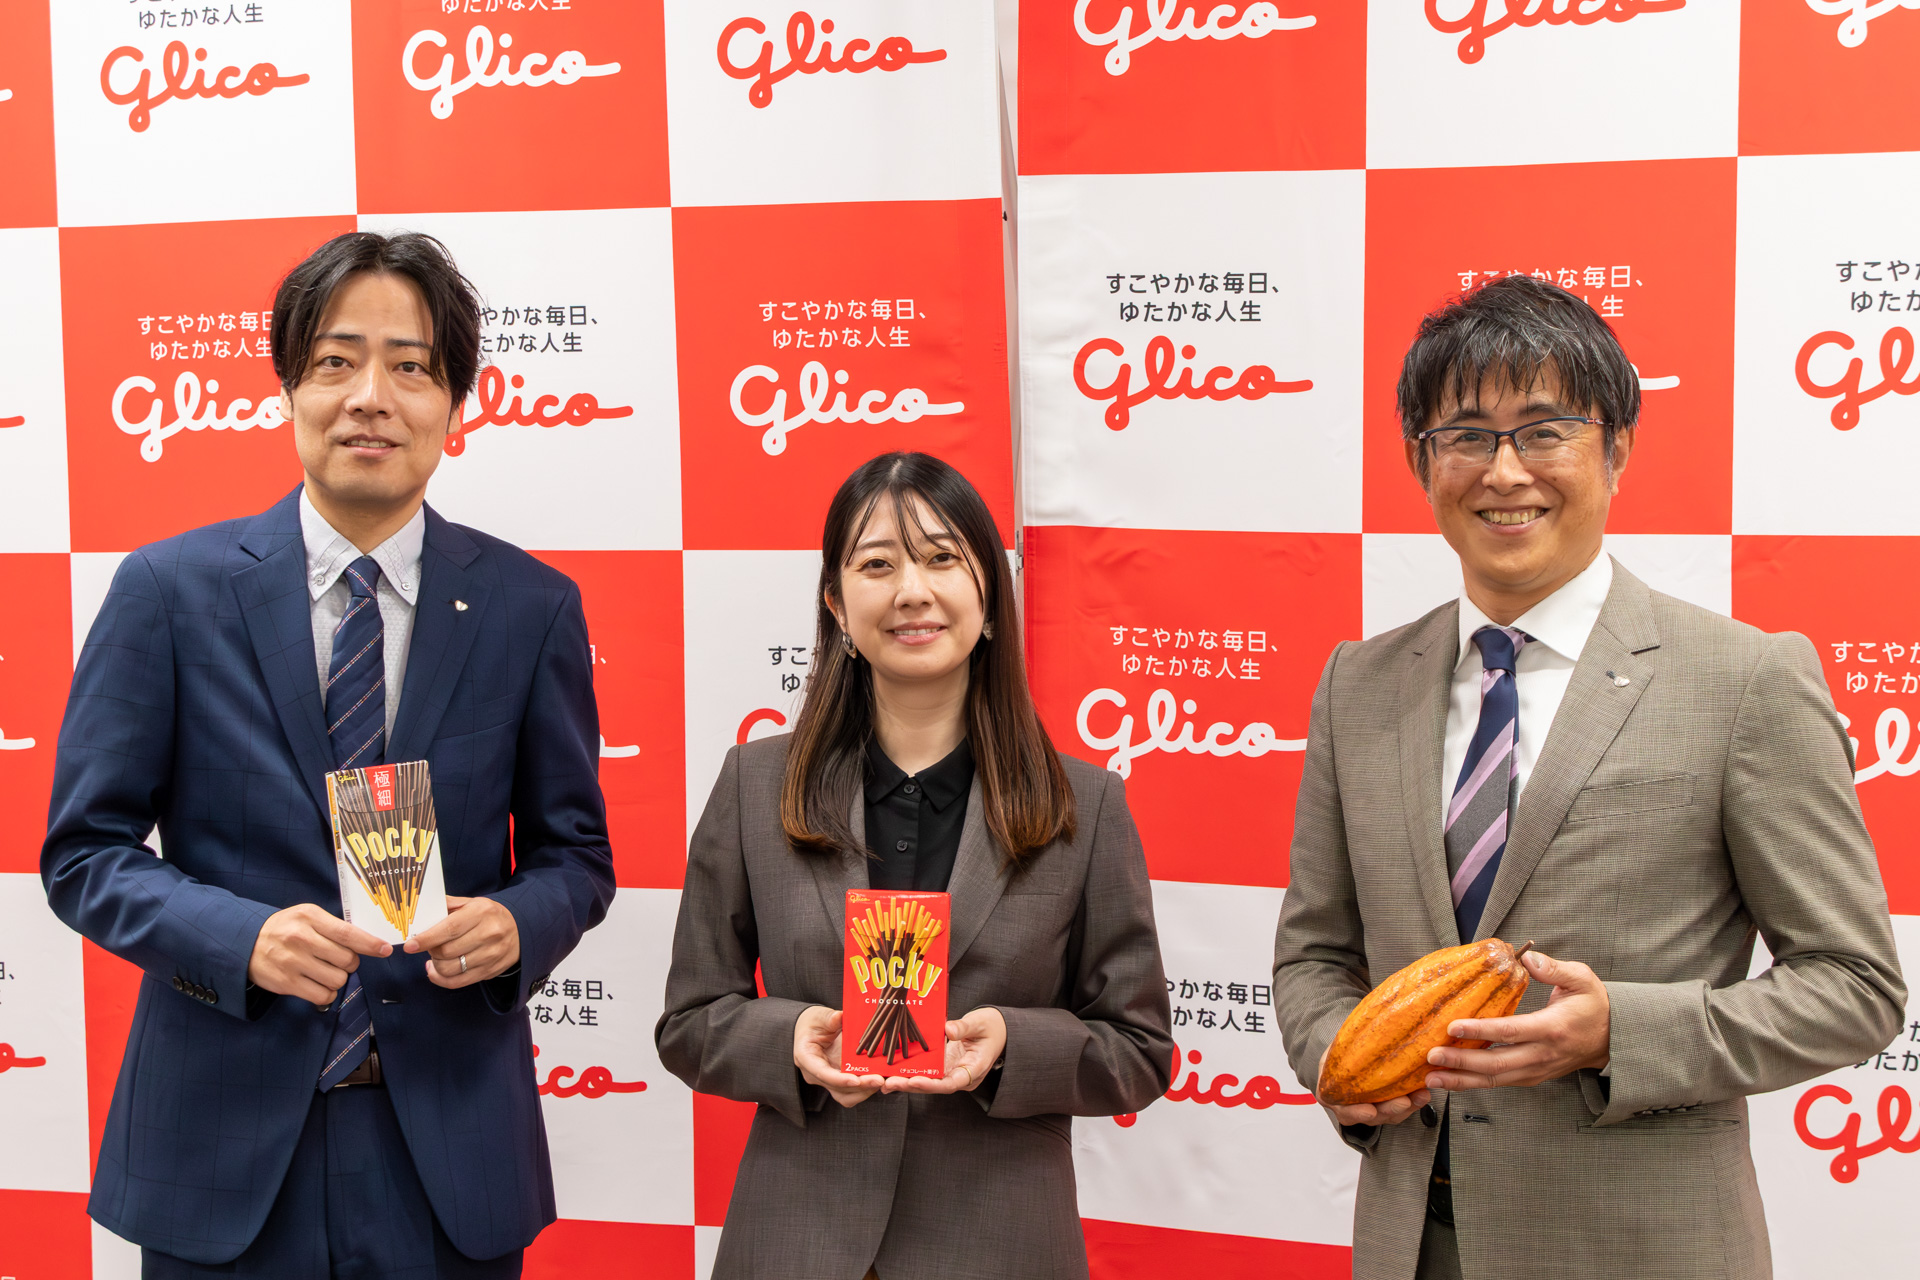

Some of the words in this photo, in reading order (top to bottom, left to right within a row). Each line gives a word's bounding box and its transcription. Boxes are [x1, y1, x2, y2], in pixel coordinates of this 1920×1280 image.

[138, 3, 264, 30] ゆたかな人生
[402, 25, 621, 119] Glico
[717, 11, 947, 109] Glico
[100, 40, 310, 133] Glico
[1106, 272, 1279, 294] すこやかな毎日、
[1835, 260, 1920, 282] すこや
[758, 299, 926, 322] すこやかな毎日、
[1119, 300, 1262, 323] ゆたかな人生
[150, 337, 272, 361] ゆたかな人生
[773, 326, 911, 349] ゆたかな人生
[1073, 335, 1313, 431] Glico
[1795, 326, 1920, 431] Gl
[112, 371, 293, 462] Glico
[730, 361, 965, 456] Glico
[1109, 625, 1278, 652] すこやかな毎日、
[768, 646, 816, 666] すこ
[1122, 654, 1261, 680] ゆたかな人生
[1076, 688, 1308, 780] Glico
[373, 770, 392, 807] 極細
[368, 865, 423, 878] CHOCOLATE
[865, 998, 923, 1006] CHOCOLATE
[1113, 1042, 1318, 1128] ico
[1794, 1084, 1920, 1184] Gl
